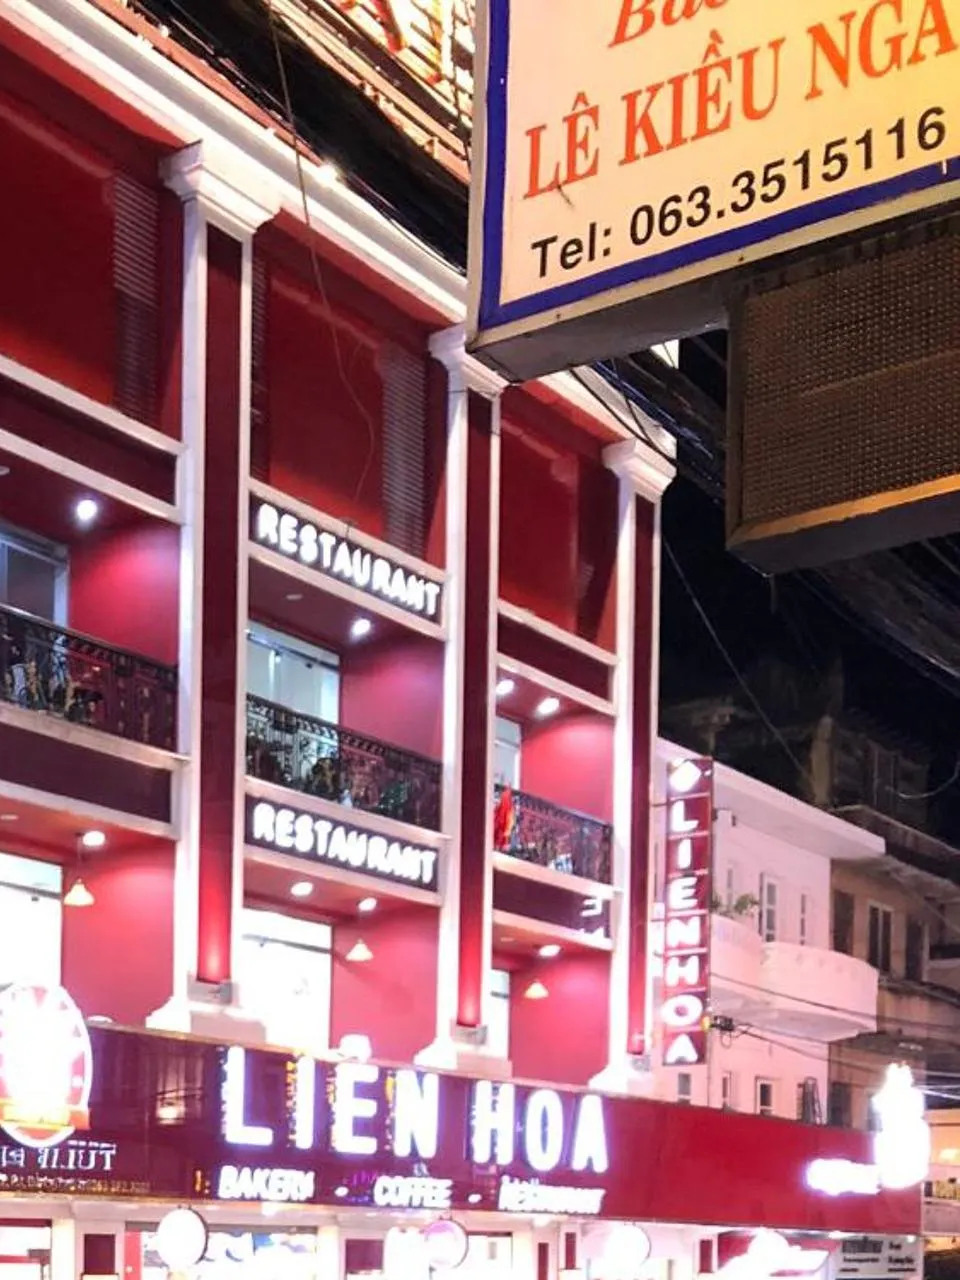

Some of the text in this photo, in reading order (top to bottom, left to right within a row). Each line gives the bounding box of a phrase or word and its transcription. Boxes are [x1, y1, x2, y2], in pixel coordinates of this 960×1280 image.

[523, 0, 959, 200] LÊ KIỀU NGA
[530, 106, 947, 279] Tel: 063.3515116
[256, 502, 441, 616] RESTAURANT
[252, 801, 437, 884] RESTAURANT
[471, 1080, 609, 1174] HOA
[218, 1164, 454, 1207] BAKERY COFFEE
